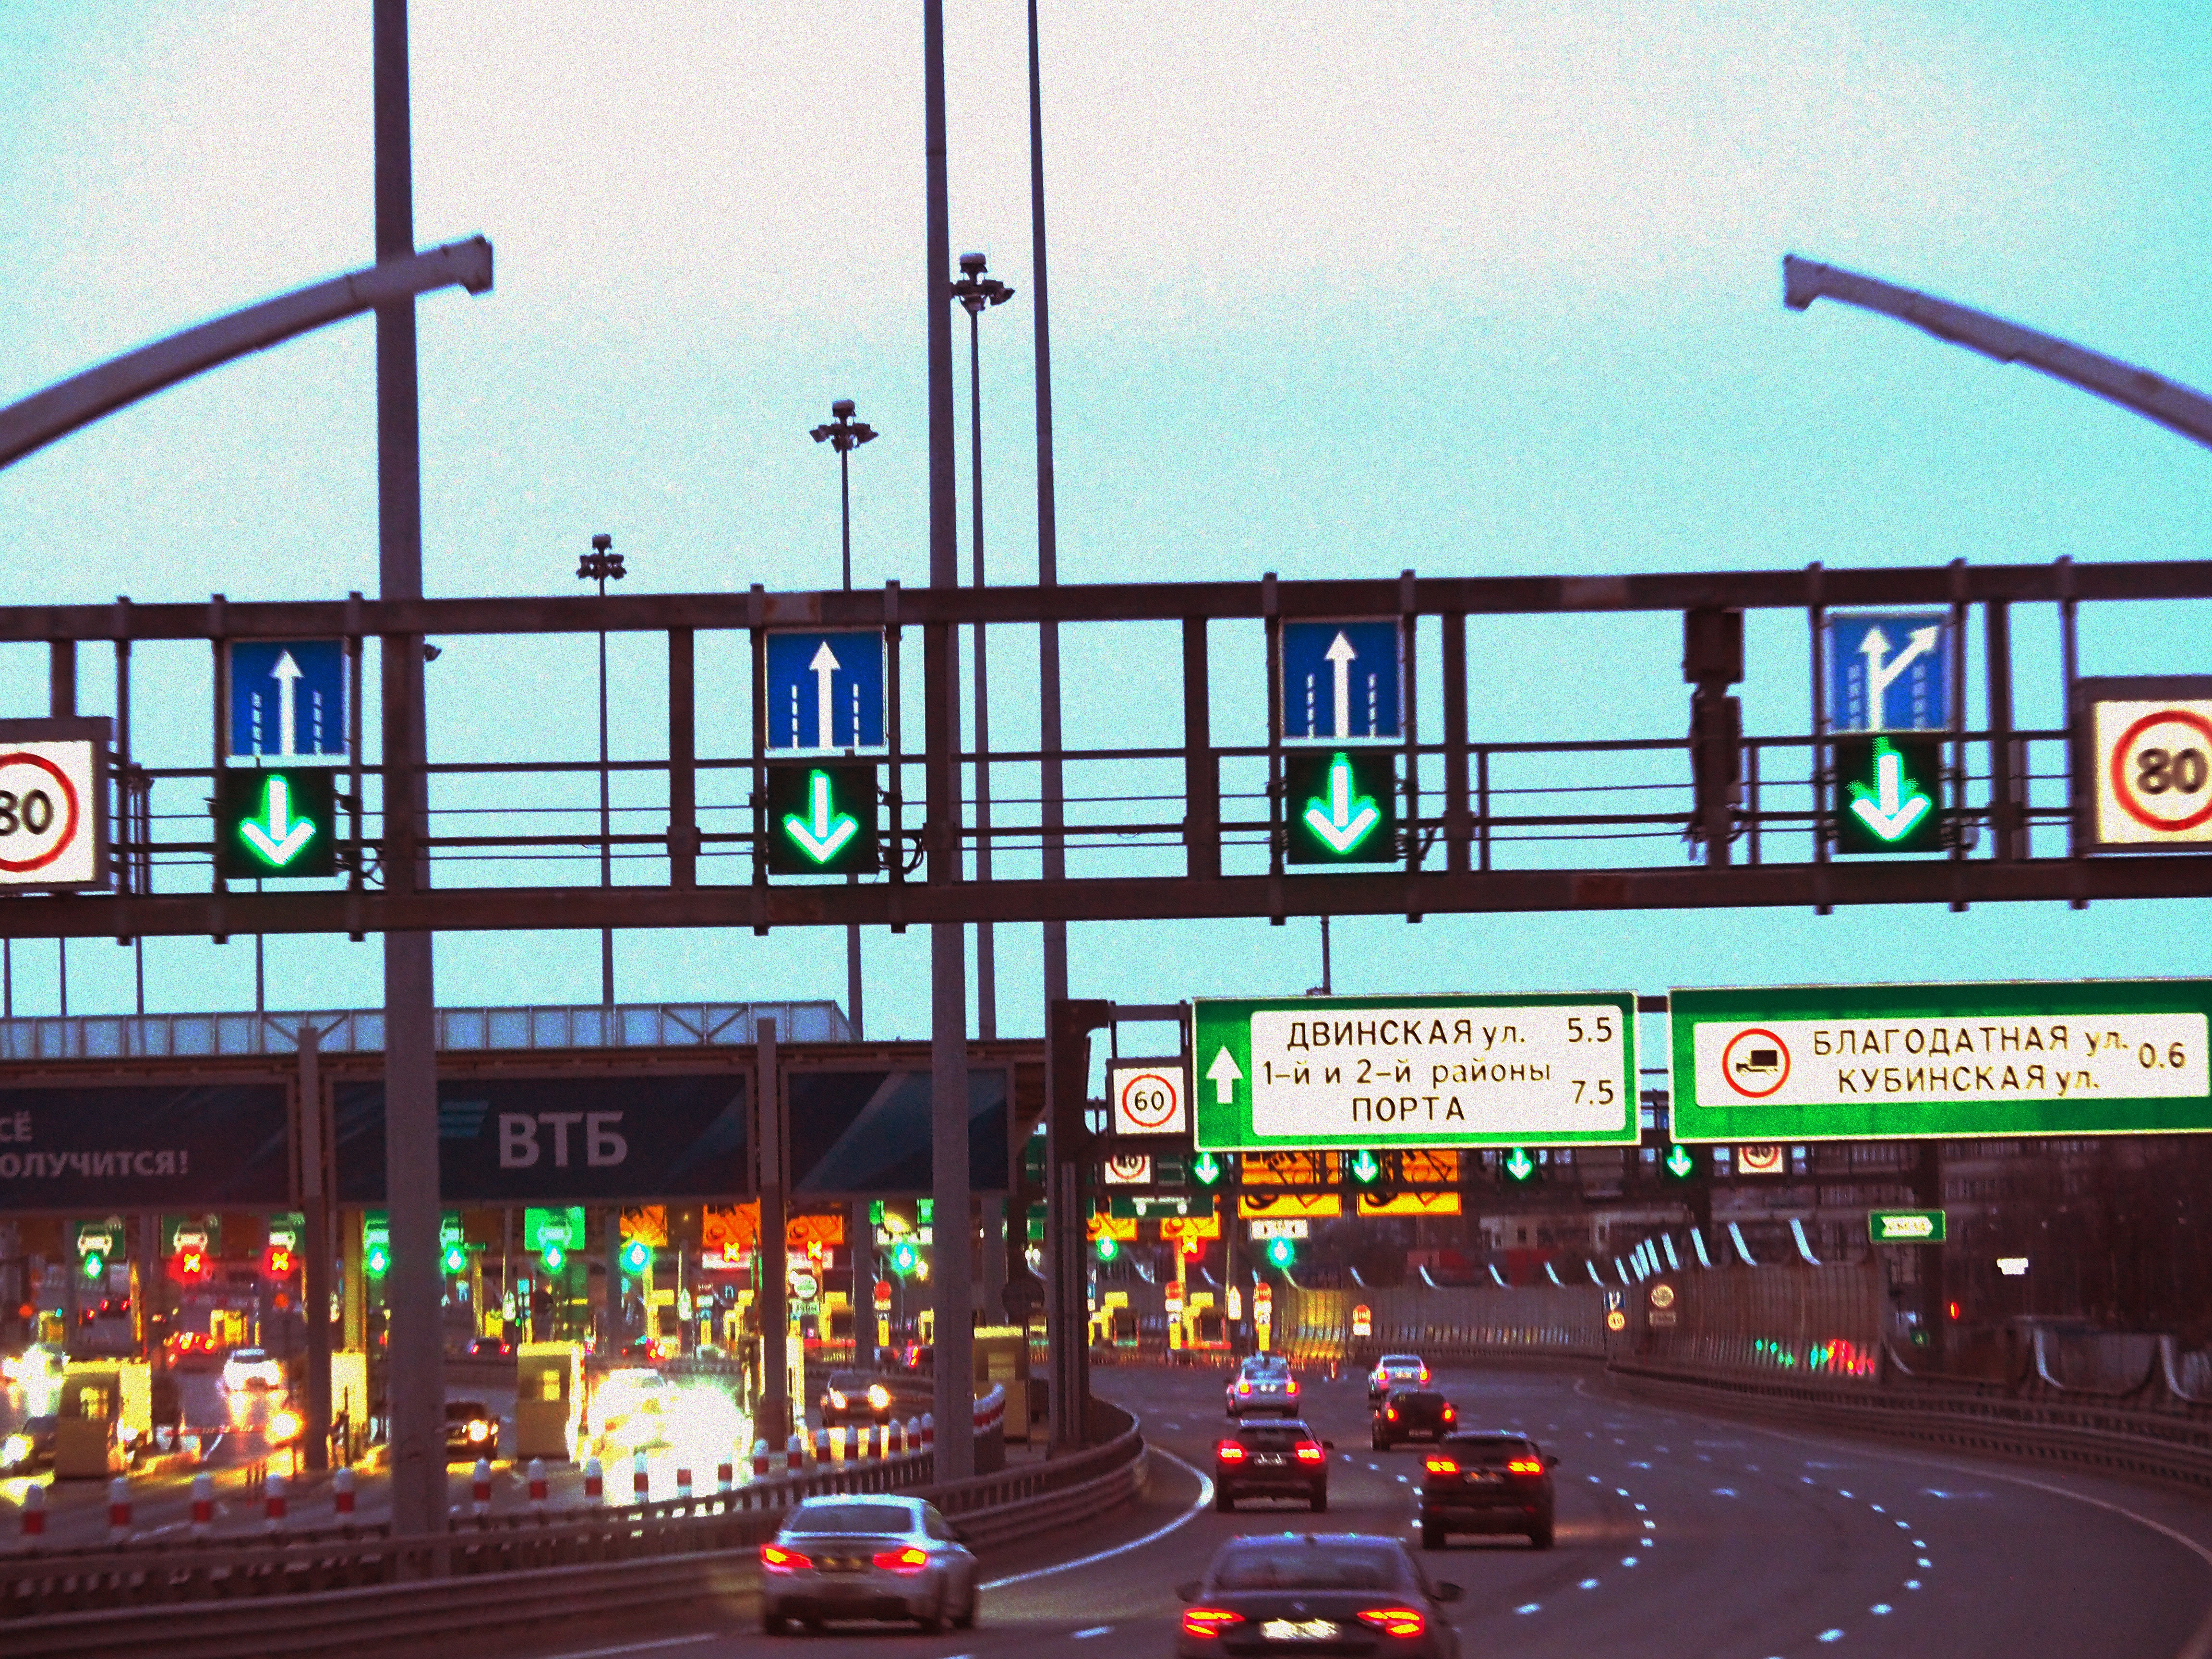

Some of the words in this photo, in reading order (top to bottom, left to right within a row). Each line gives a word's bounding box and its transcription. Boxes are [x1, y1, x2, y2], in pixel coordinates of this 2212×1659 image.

[2137, 748, 2208, 795] 80
[1286, 1019, 1472, 1051] ДВИНСКАЯ
[1482, 1025, 1525, 1050] ул.
[1567, 1017, 1613, 1043] 5.5
[1815, 1025, 2068, 1056] БЛАГОДАТНАЯ
[2085, 1031, 2128, 1057] ул.
[2139, 1042, 2185, 1069] 0.6
[1264, 1060, 1310, 1085] 1-й
[1324, 1067, 1341, 1084] и
[1356, 1058, 1411, 1084] 2-й
[1432, 1058, 1550, 1089] районы
[1838, 1064, 2044, 1093] КУБИНСКАЯ
[2053, 1071, 2100, 1096] ул.
[1134, 1091, 1165, 1111] 60
[1572, 1080, 1614, 1105] 7.5
[1352, 1095, 1465, 1122] ПОРТА
[499, 1111, 628, 1168] ВТБ
